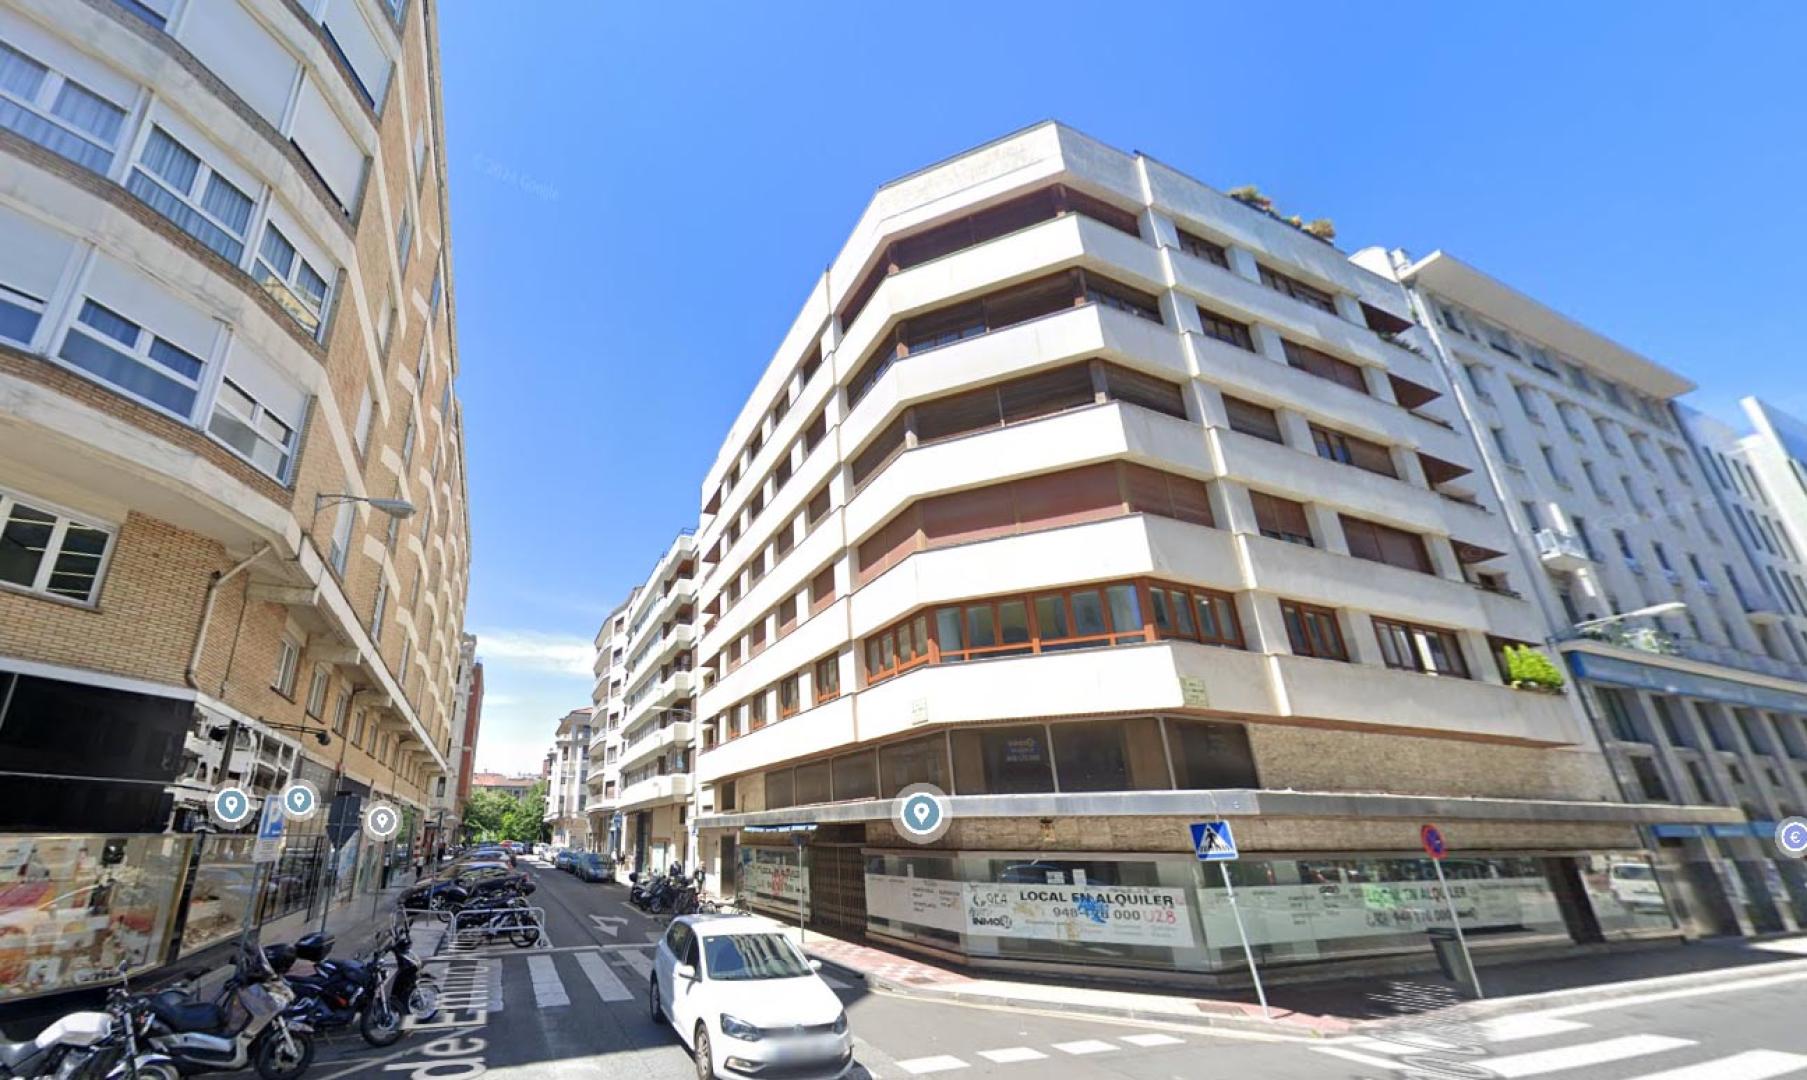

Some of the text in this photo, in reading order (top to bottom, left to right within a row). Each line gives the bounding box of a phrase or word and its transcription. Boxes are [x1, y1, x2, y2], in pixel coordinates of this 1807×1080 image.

[1020, 891, 1068, 902] LOCAL
[1096, 892, 1174, 907] ALQUILER
[1114, 909, 1141, 921] 000
